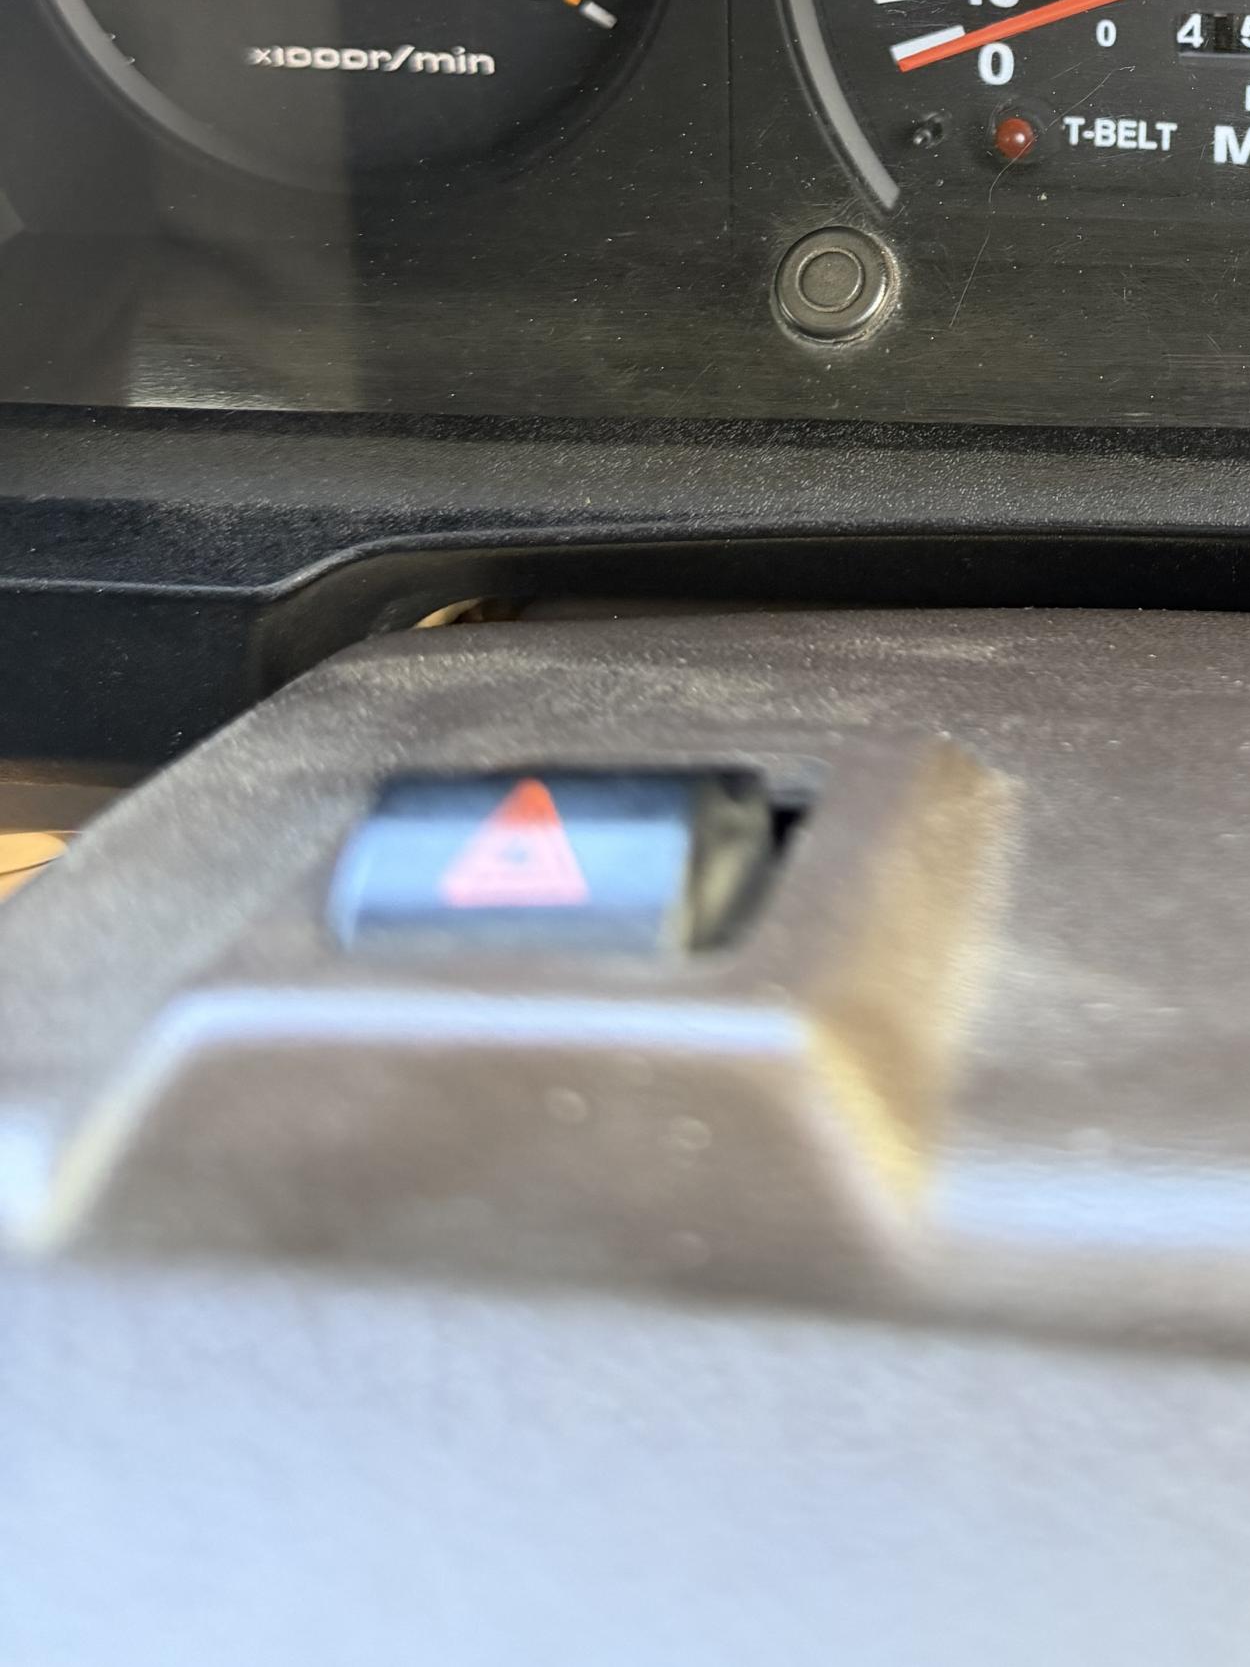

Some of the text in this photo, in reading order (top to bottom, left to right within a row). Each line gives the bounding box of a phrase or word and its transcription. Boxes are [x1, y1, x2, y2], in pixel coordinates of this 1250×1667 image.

[1095, 20, 1117, 47] 0
[977, 43, 1016, 86] 0
[1062, 116, 1179, 152] T-BELT
